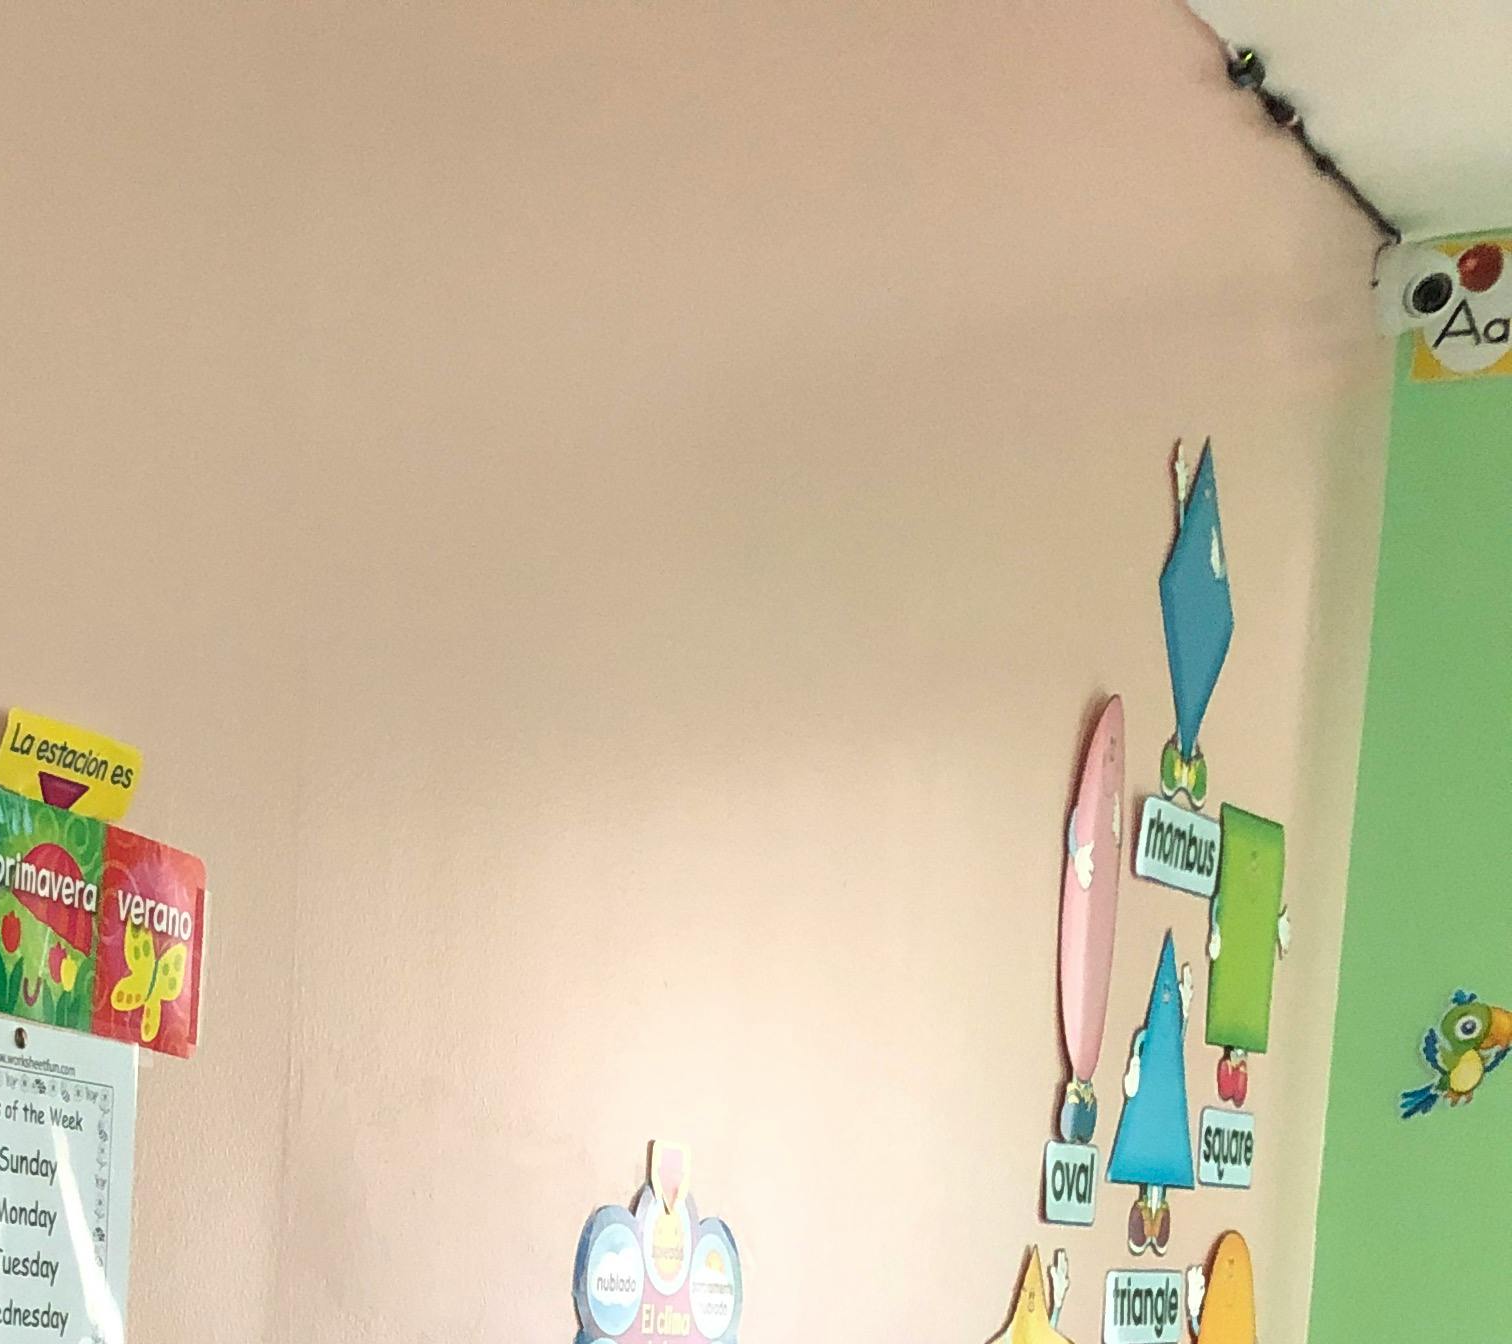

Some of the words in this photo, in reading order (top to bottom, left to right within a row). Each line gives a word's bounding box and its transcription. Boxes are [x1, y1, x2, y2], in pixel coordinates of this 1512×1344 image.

[1431, 299, 1512, 350] Aa
[11, 721, 34, 755] La
[37, 734, 110, 780] estación
[110, 766, 134, 789] es
[1144, 817, 1216, 879] rhombus
[117, 889, 192, 941] verano
[5, 1099, 19, 1119] of
[22, 1103, 45, 1125] the
[49, 1106, 84, 1132] Week
[1051, 1151, 1095, 1204] oval
[1203, 1125, 1253, 1182] square
[1112, 1279, 1179, 1339] triangle
